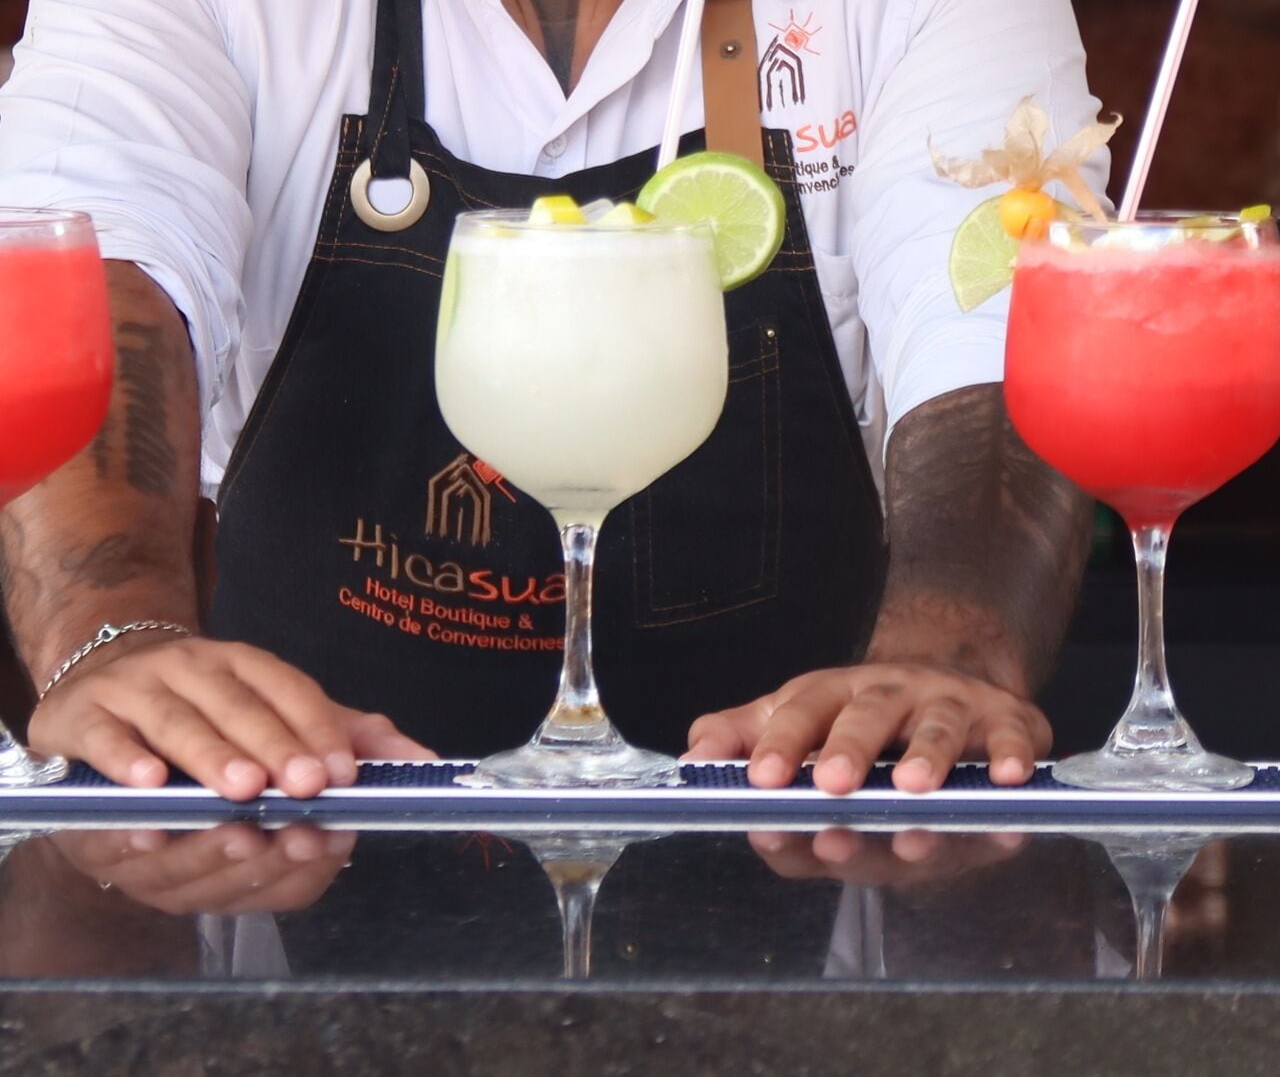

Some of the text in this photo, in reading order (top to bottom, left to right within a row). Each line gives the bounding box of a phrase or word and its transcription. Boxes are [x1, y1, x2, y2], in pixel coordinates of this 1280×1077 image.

[795, 161, 829, 178] tique
[338, 517, 567, 604] Hicasua
[339, 587, 566, 651] Centro de Convenciones
[366, 577, 534, 631] Hotel Boutique &
